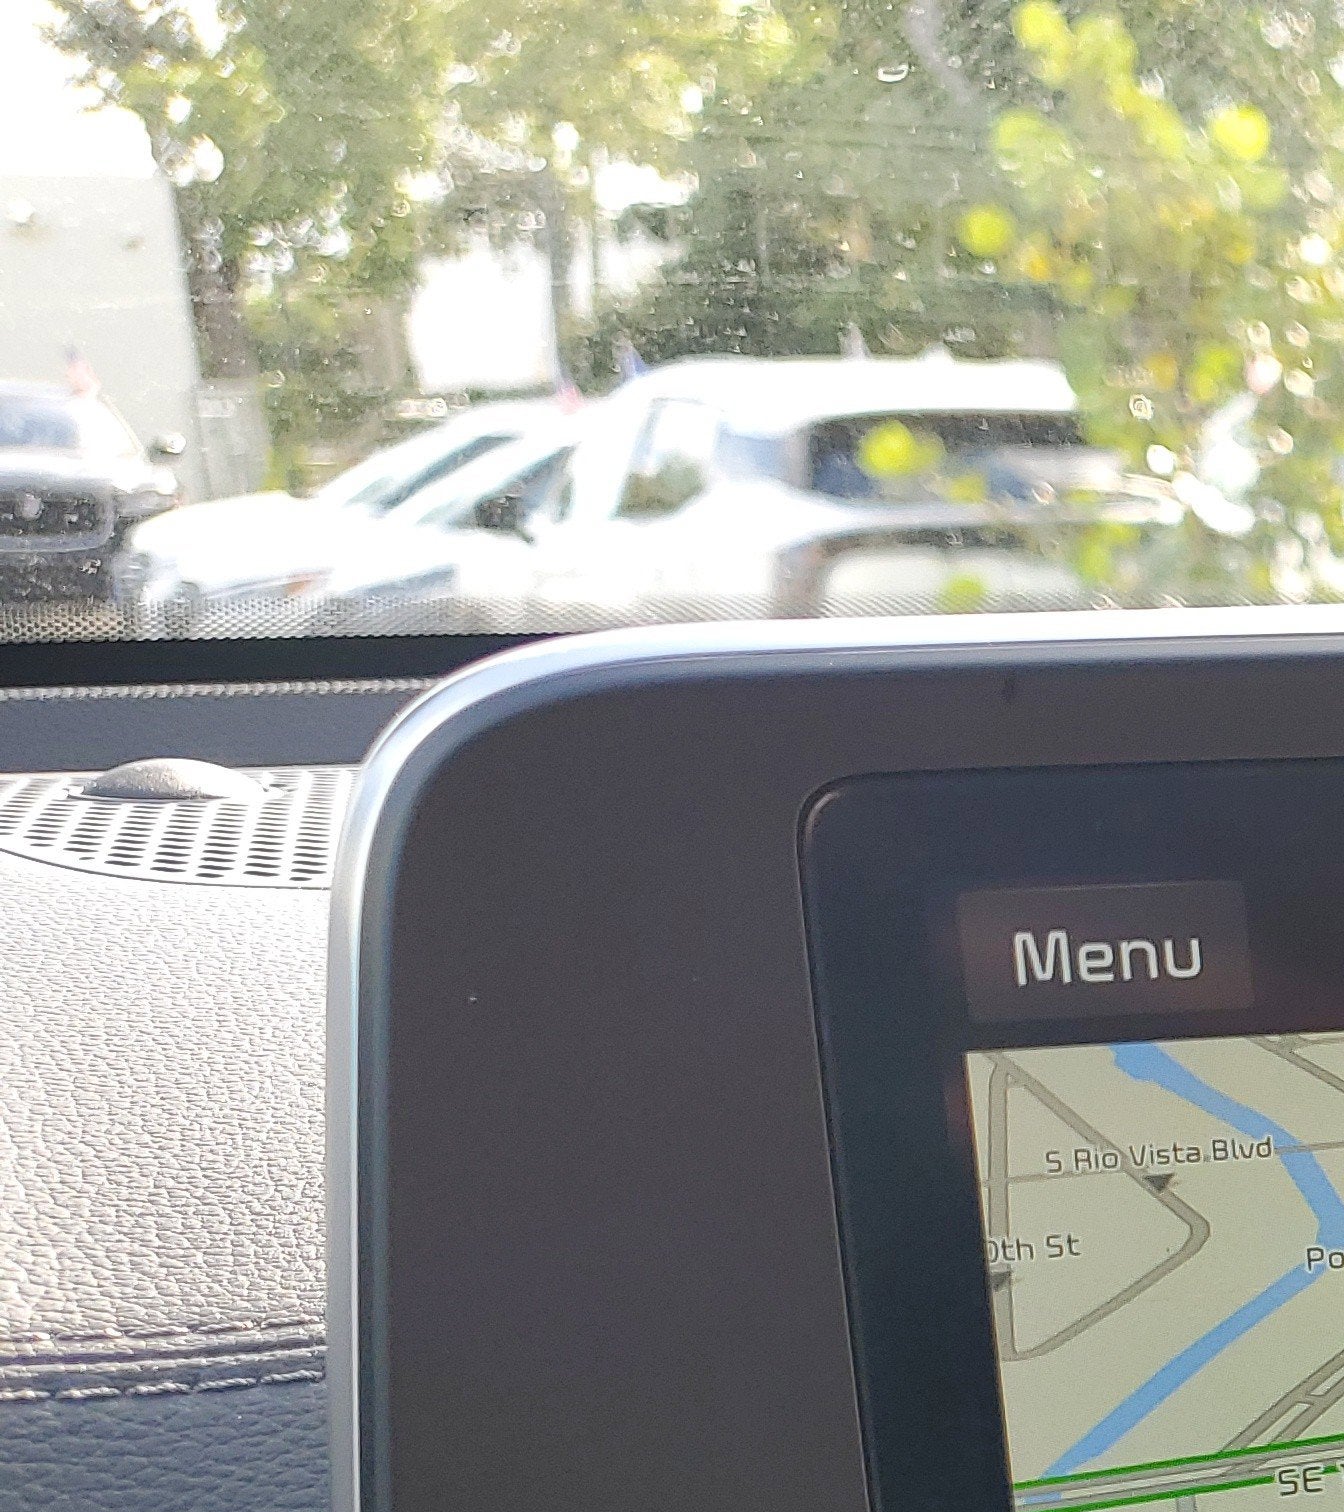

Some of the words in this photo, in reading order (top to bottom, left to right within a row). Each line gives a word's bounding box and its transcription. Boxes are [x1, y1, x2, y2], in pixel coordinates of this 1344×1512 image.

[1013, 928, 1202, 987] Menu
[1045, 1151, 1062, 1174] S
[1073, 1147, 1120, 1170] Rio
[1129, 1143, 1202, 1166] Vista
[1211, 1135, 1273, 1162] Blvd
[1046, 1234, 1081, 1259] St
[1276, 1467, 1324, 1496] SE
